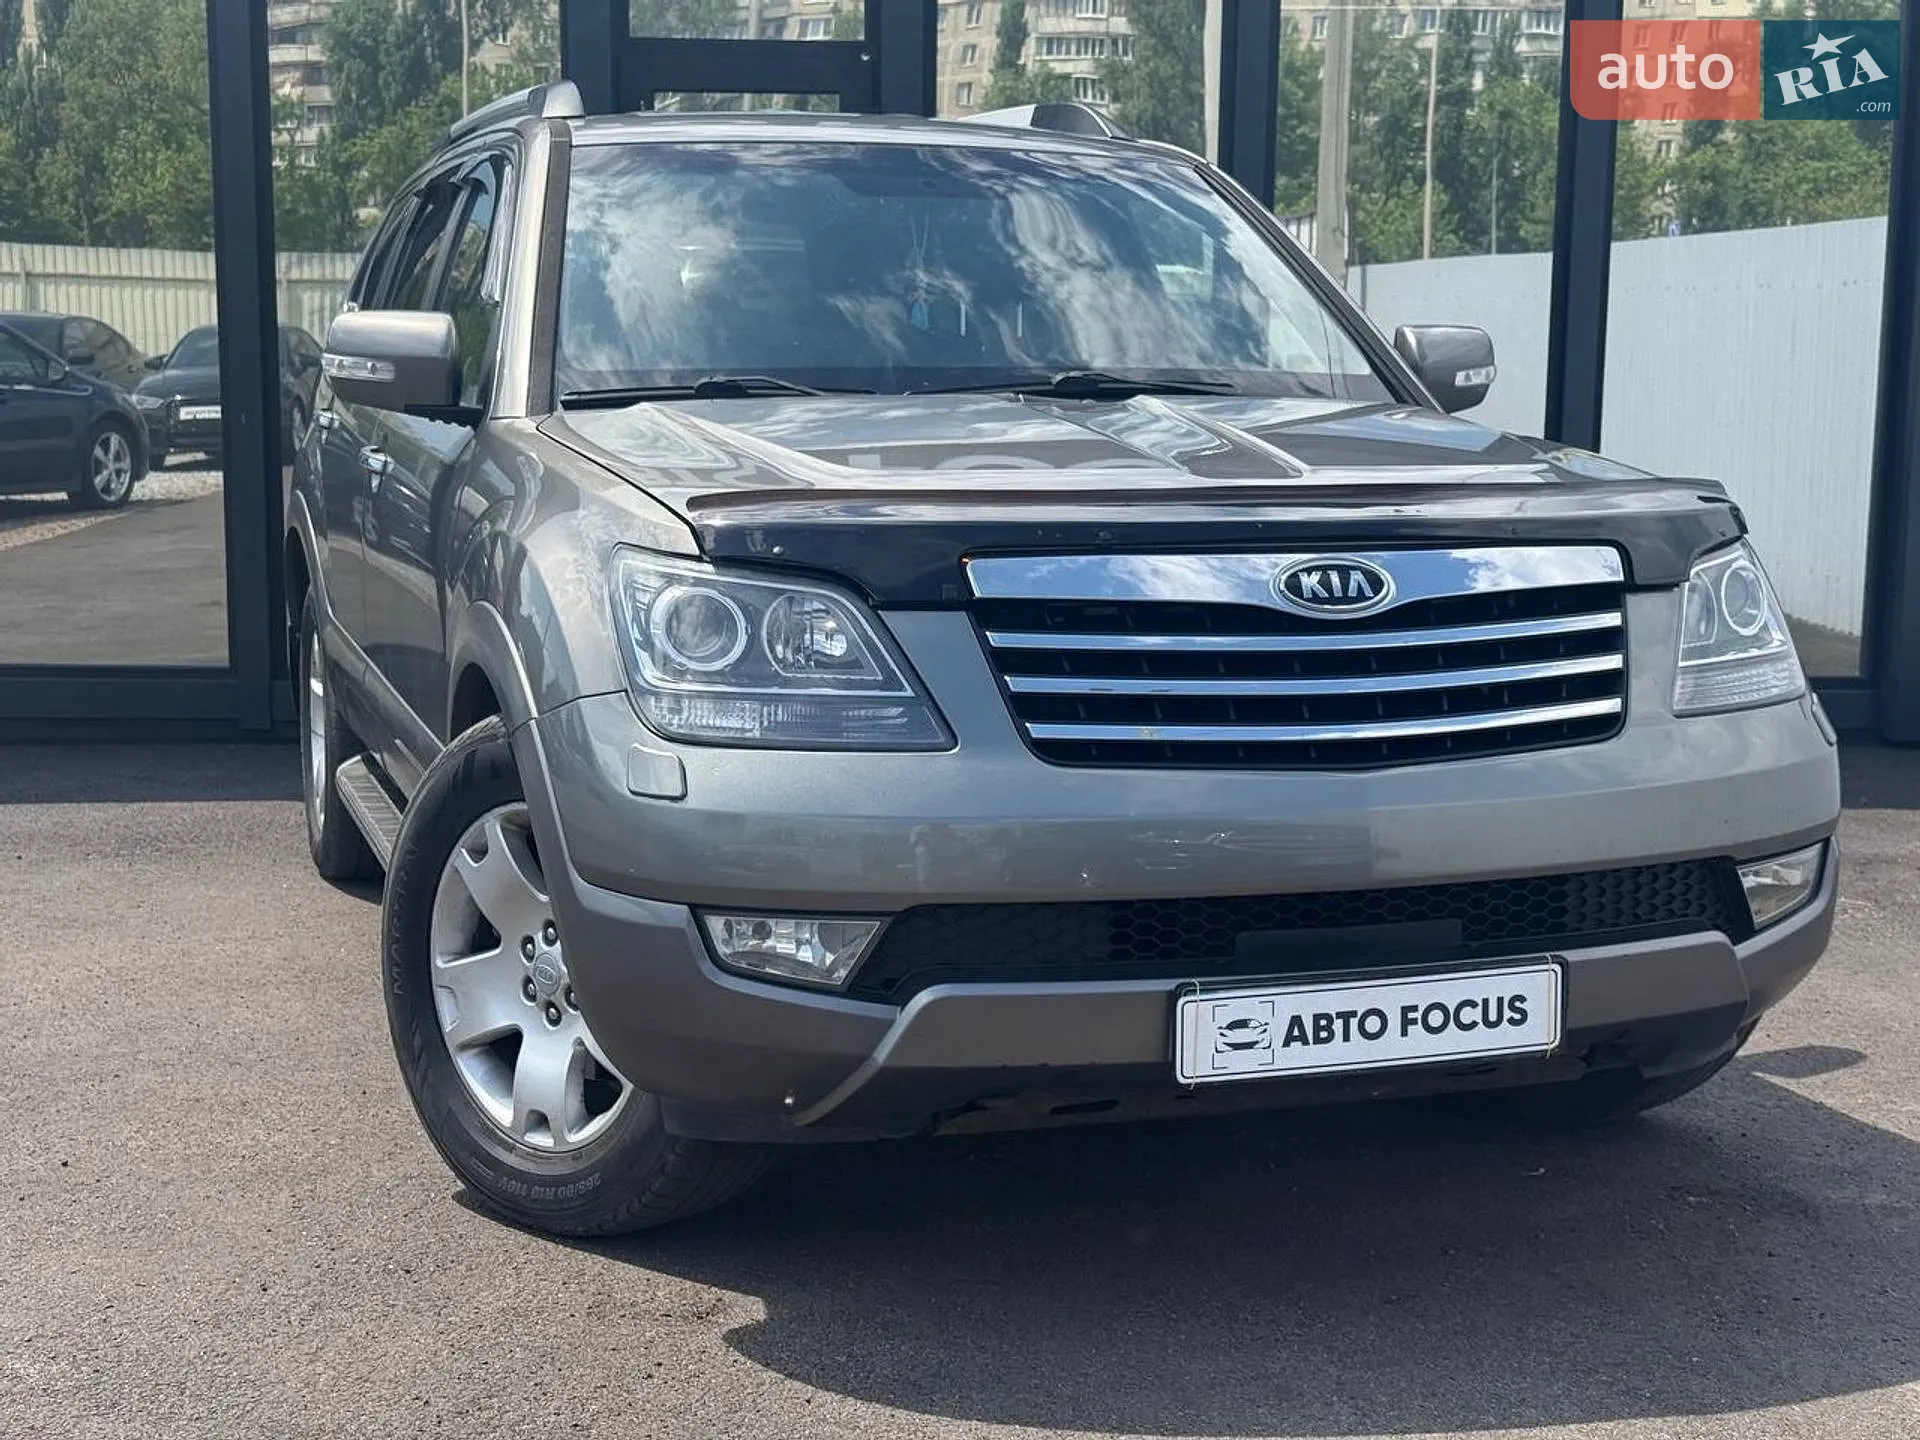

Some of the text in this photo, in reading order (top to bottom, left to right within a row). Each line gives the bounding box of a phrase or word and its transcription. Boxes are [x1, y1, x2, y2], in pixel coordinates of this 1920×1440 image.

[1297, 570, 1375, 599] KIA
[1282, 994, 1528, 1049] АВТО FOCUS
